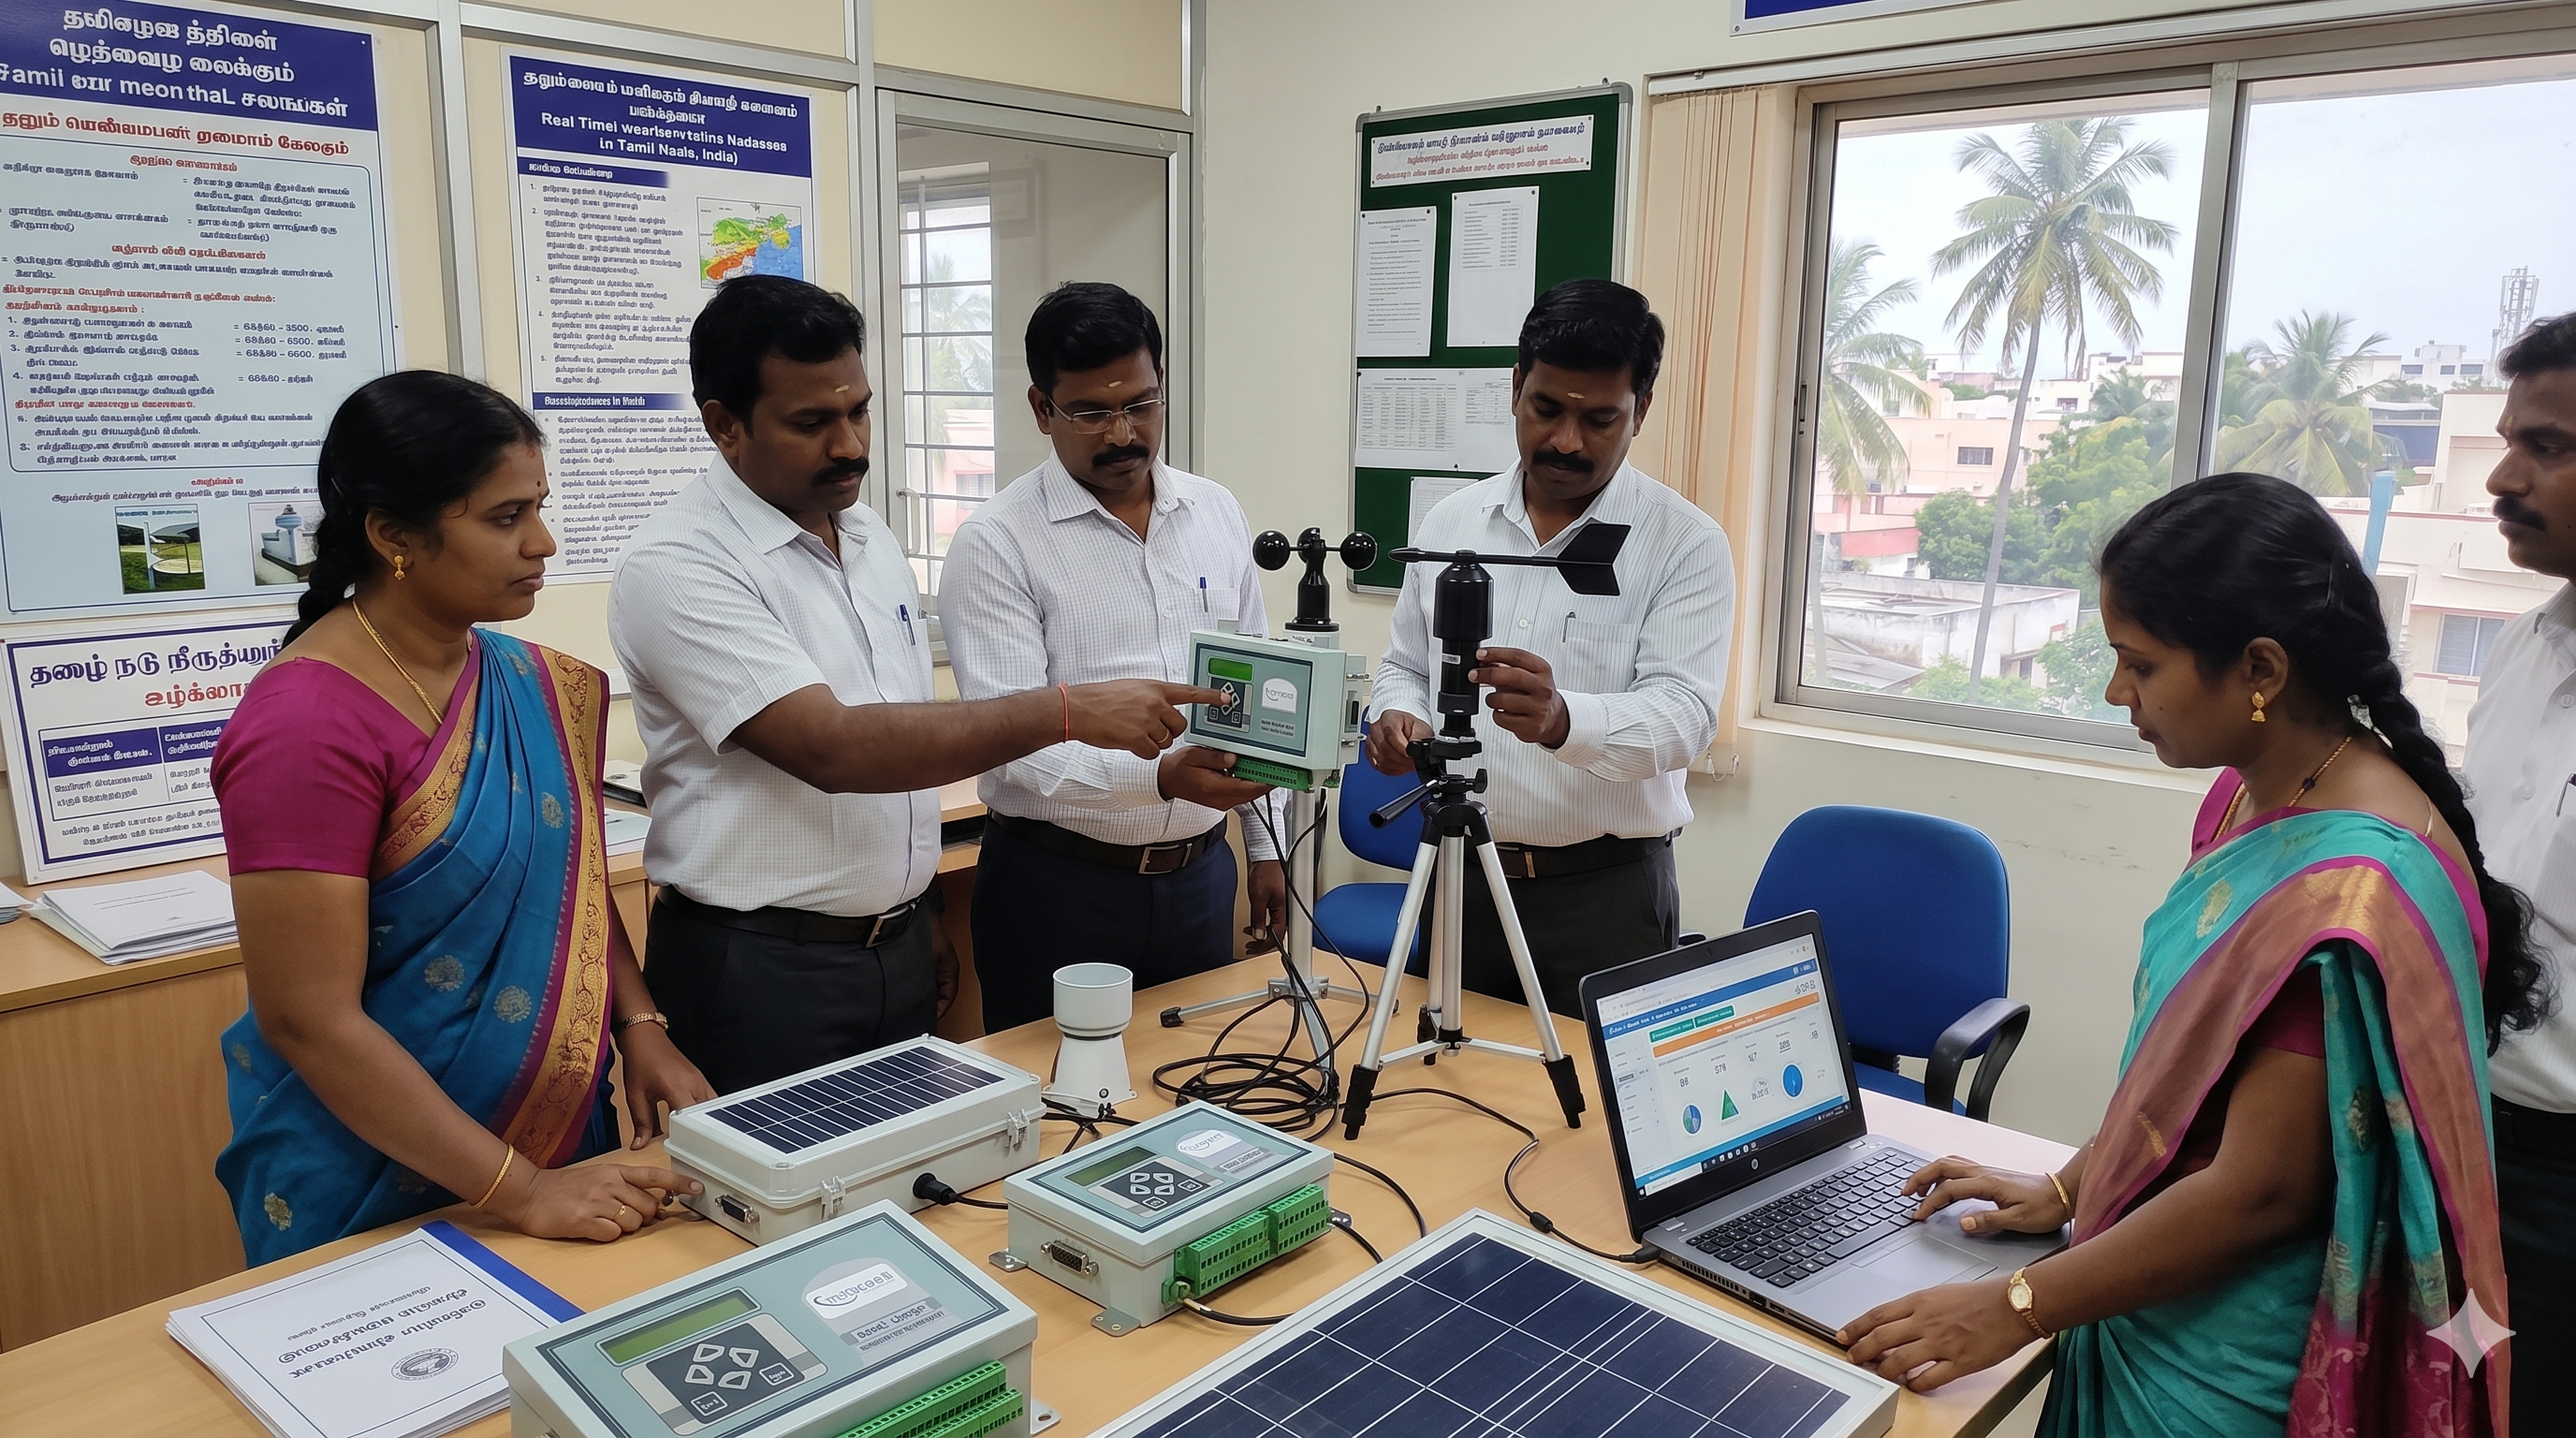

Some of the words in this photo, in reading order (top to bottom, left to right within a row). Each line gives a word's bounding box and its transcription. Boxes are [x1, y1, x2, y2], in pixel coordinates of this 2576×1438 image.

[541, 112, 574, 128] Real
[617, 139, 654, 154] Tamil
[702, 148, 738, 166] India)
[115, 653, 160, 680] நடு
